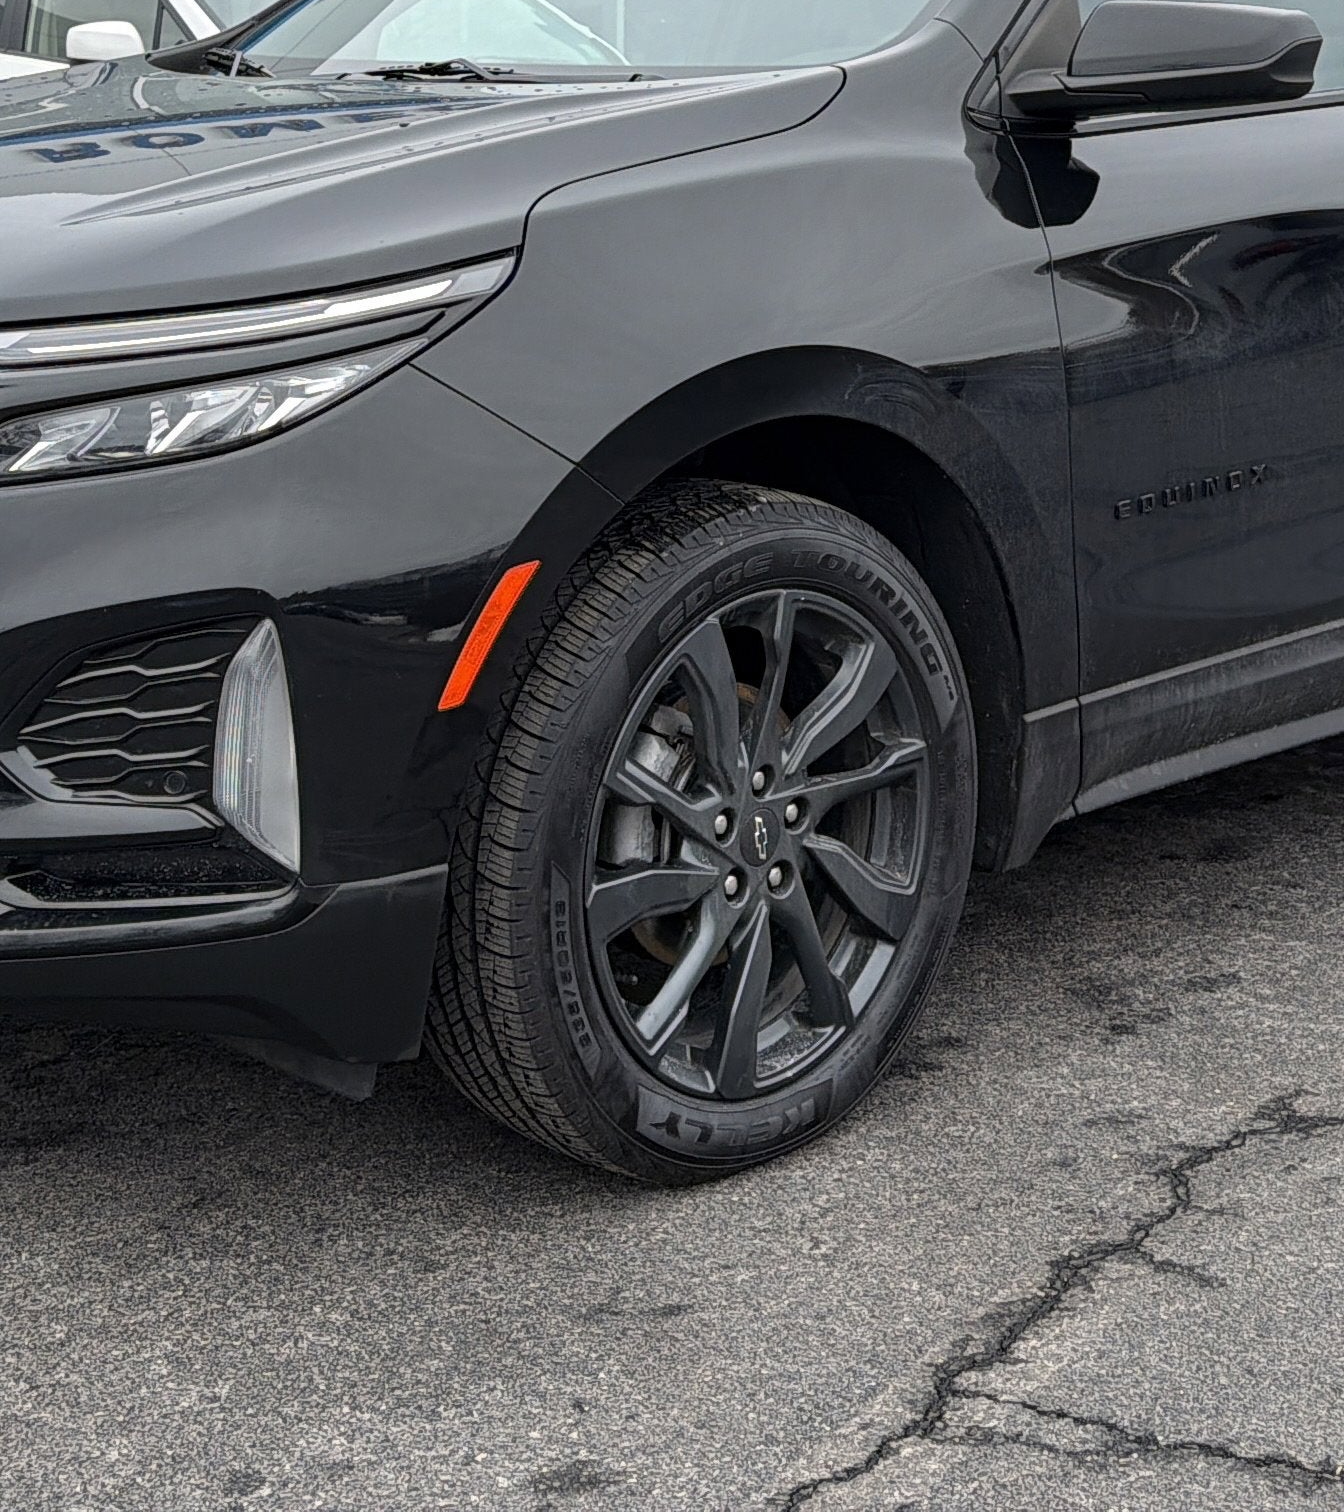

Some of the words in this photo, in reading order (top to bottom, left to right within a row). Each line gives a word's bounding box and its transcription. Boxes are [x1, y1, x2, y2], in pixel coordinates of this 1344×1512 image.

[659, 551, 774, 644] EDGE
[790, 549, 943, 677] TOURING
[648, 1098, 816, 1148] KELLY
